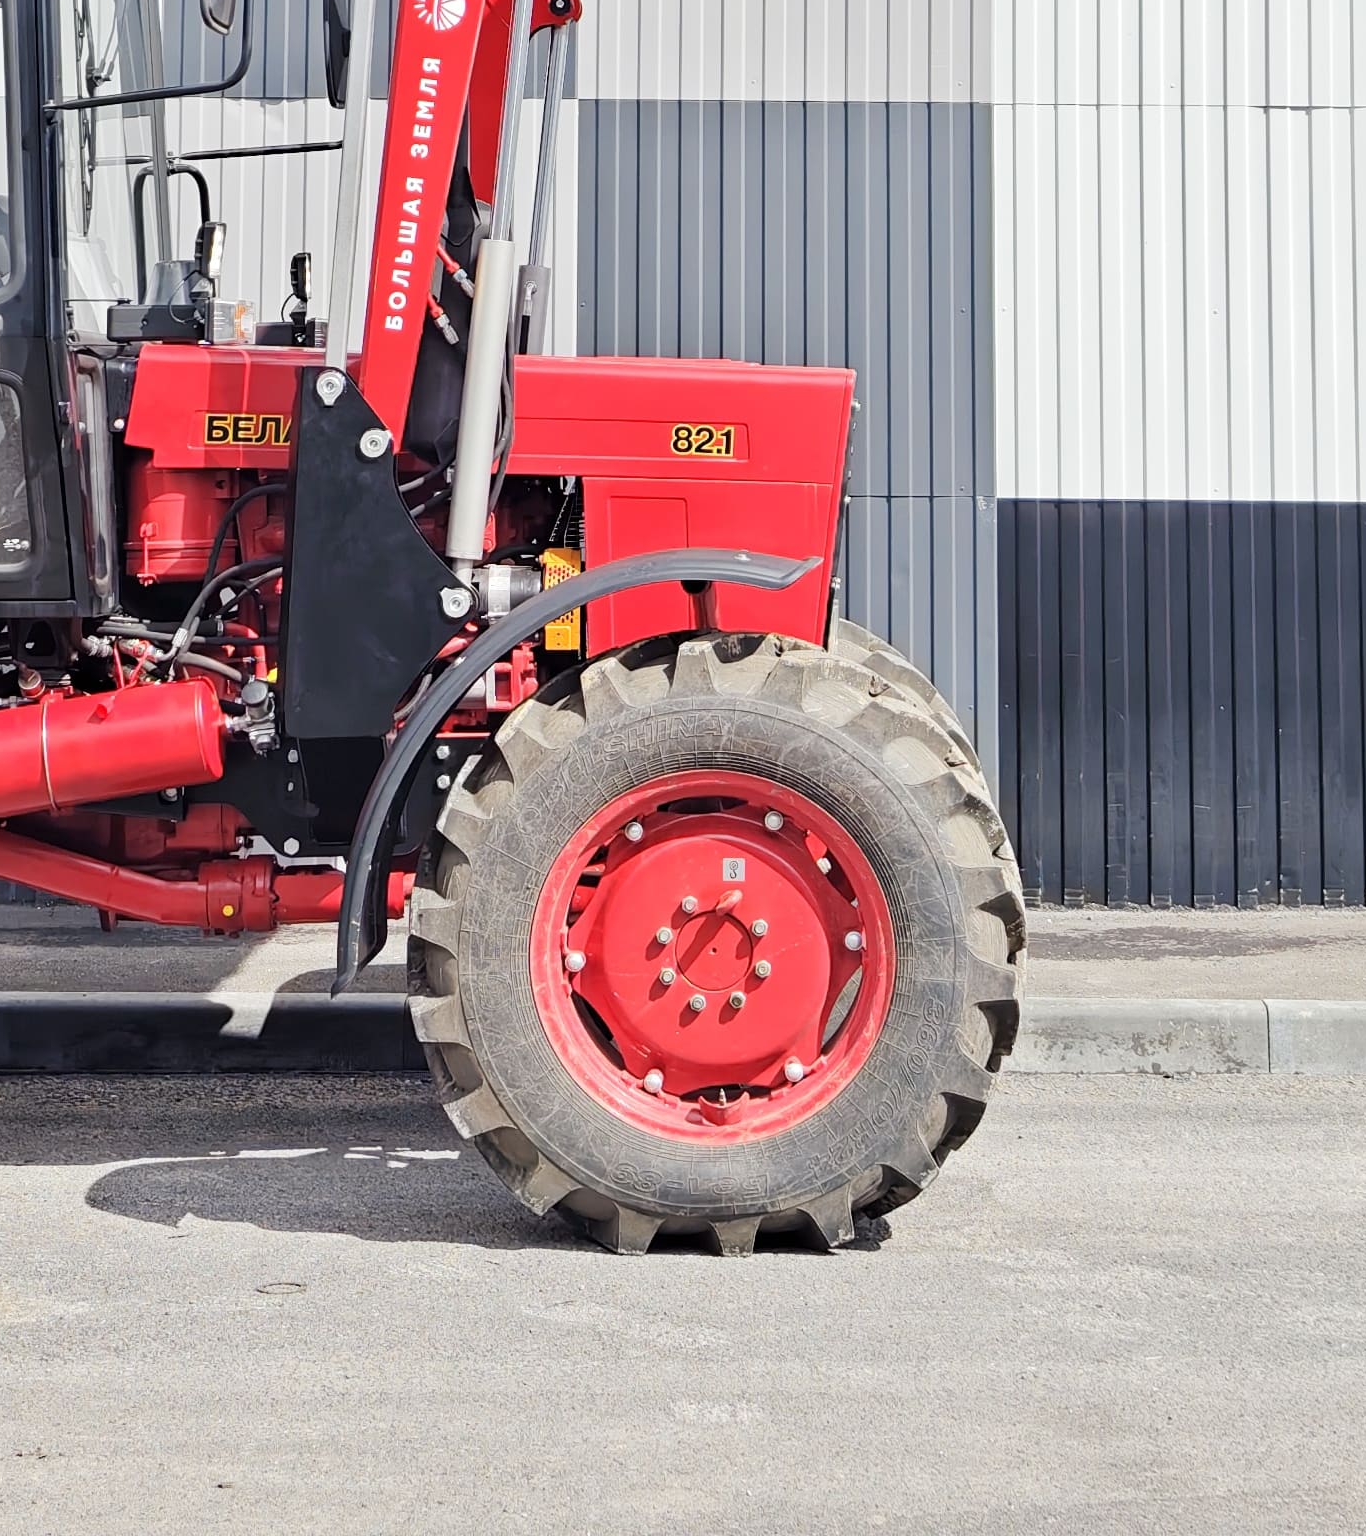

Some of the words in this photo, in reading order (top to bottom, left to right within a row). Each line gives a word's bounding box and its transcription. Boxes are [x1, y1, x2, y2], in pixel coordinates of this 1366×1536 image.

[385, 177, 424, 331] БОЛЬШАЯ
[411, 57, 441, 159] ЗЕМЛЯ
[670, 423, 734, 457] 82.1
